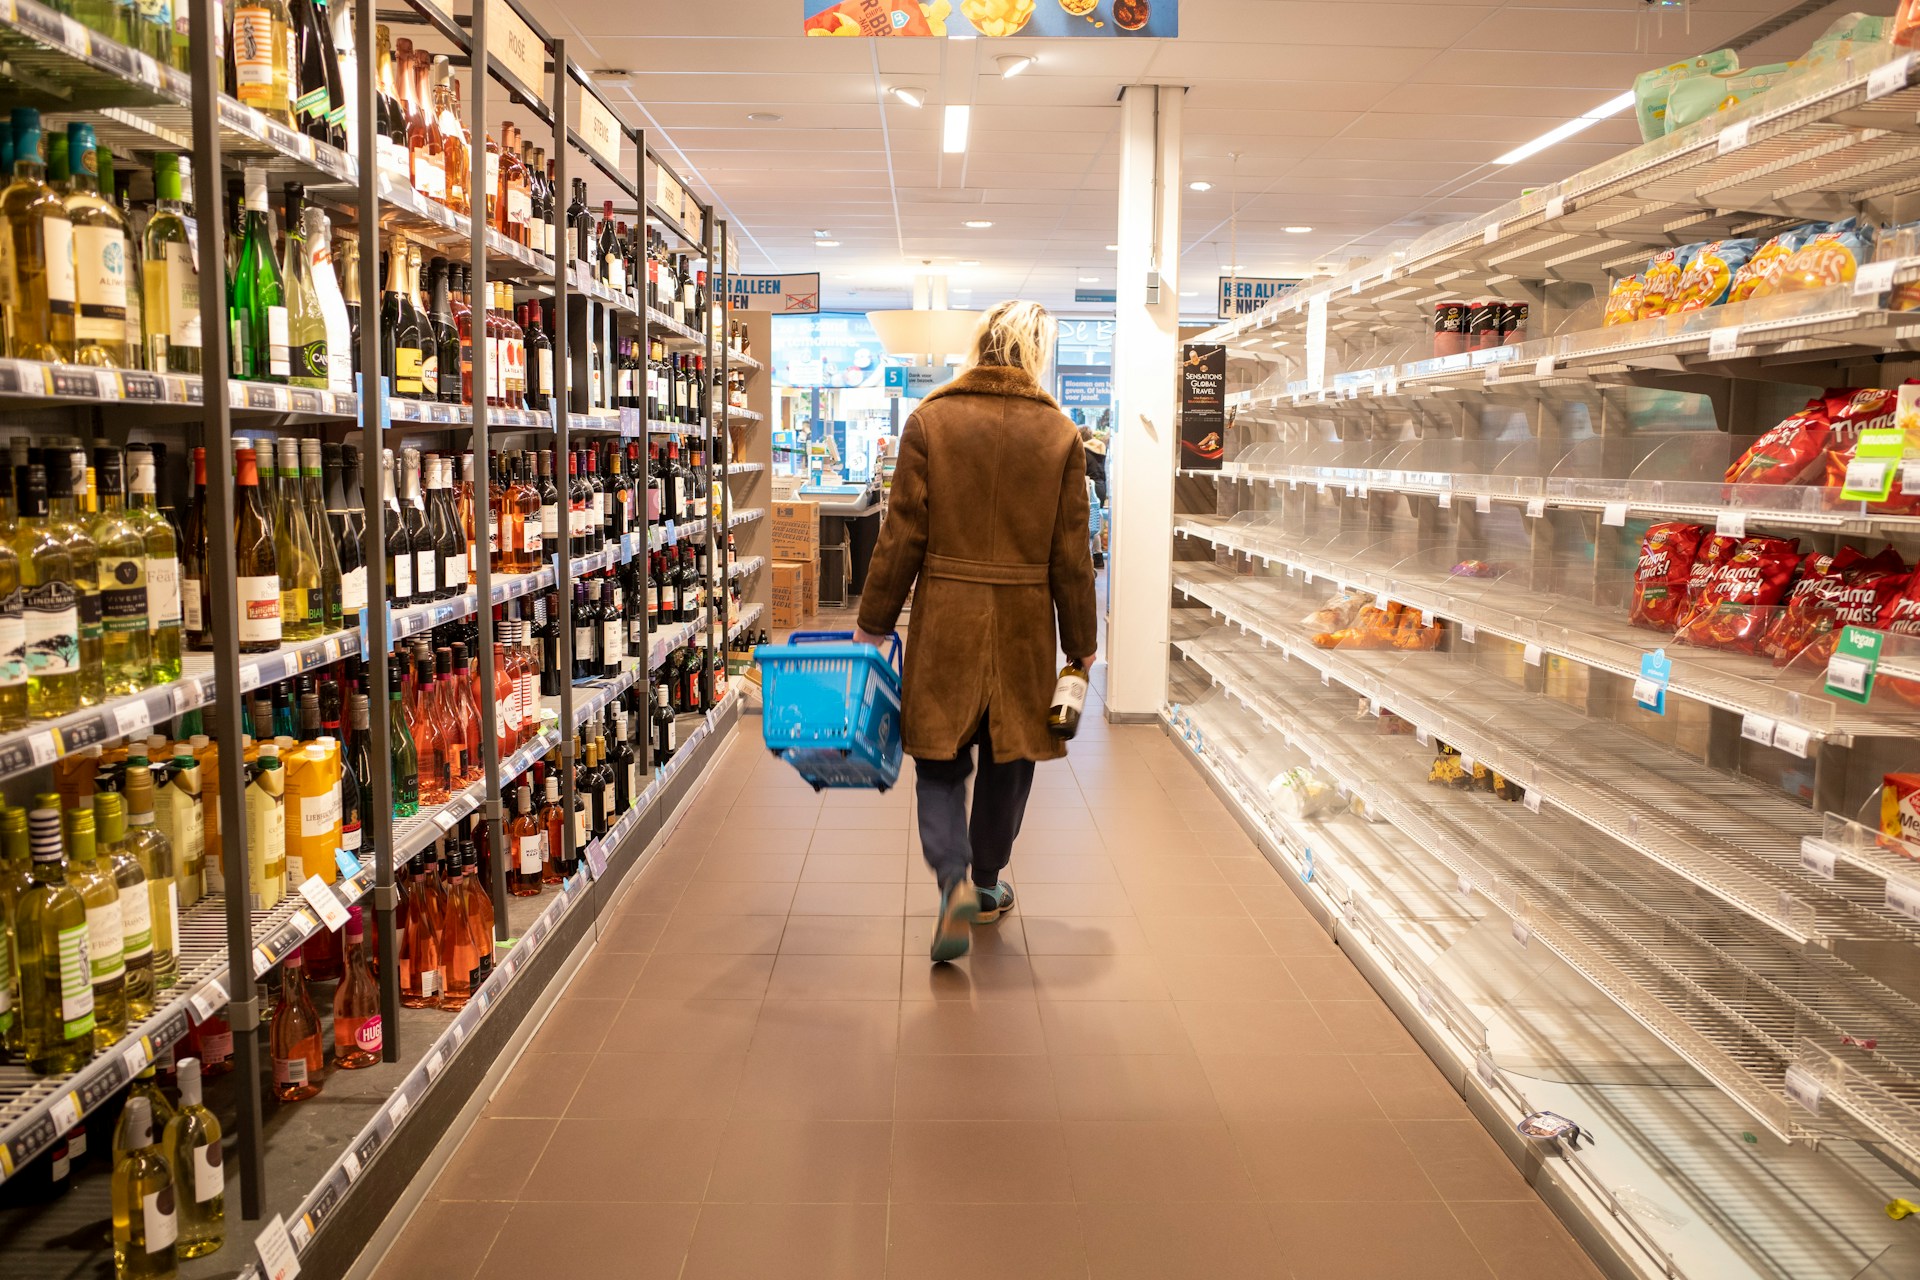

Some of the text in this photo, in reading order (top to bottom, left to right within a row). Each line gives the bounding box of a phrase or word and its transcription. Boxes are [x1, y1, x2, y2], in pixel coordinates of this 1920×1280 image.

[508, 30, 526, 62] ROSÉ
[734, 279, 781, 294] ALLEEN
[1224, 282, 1252, 298] HER
[889, 371, 898, 384] 5
[1185, 372, 1223, 380] SENSATIONS
[1190, 380, 1218, 388] GLOBAL
[38, 500, 47, 513] L
[124, 567, 132, 578] V
[1850, 629, 1876, 649] Vegan
